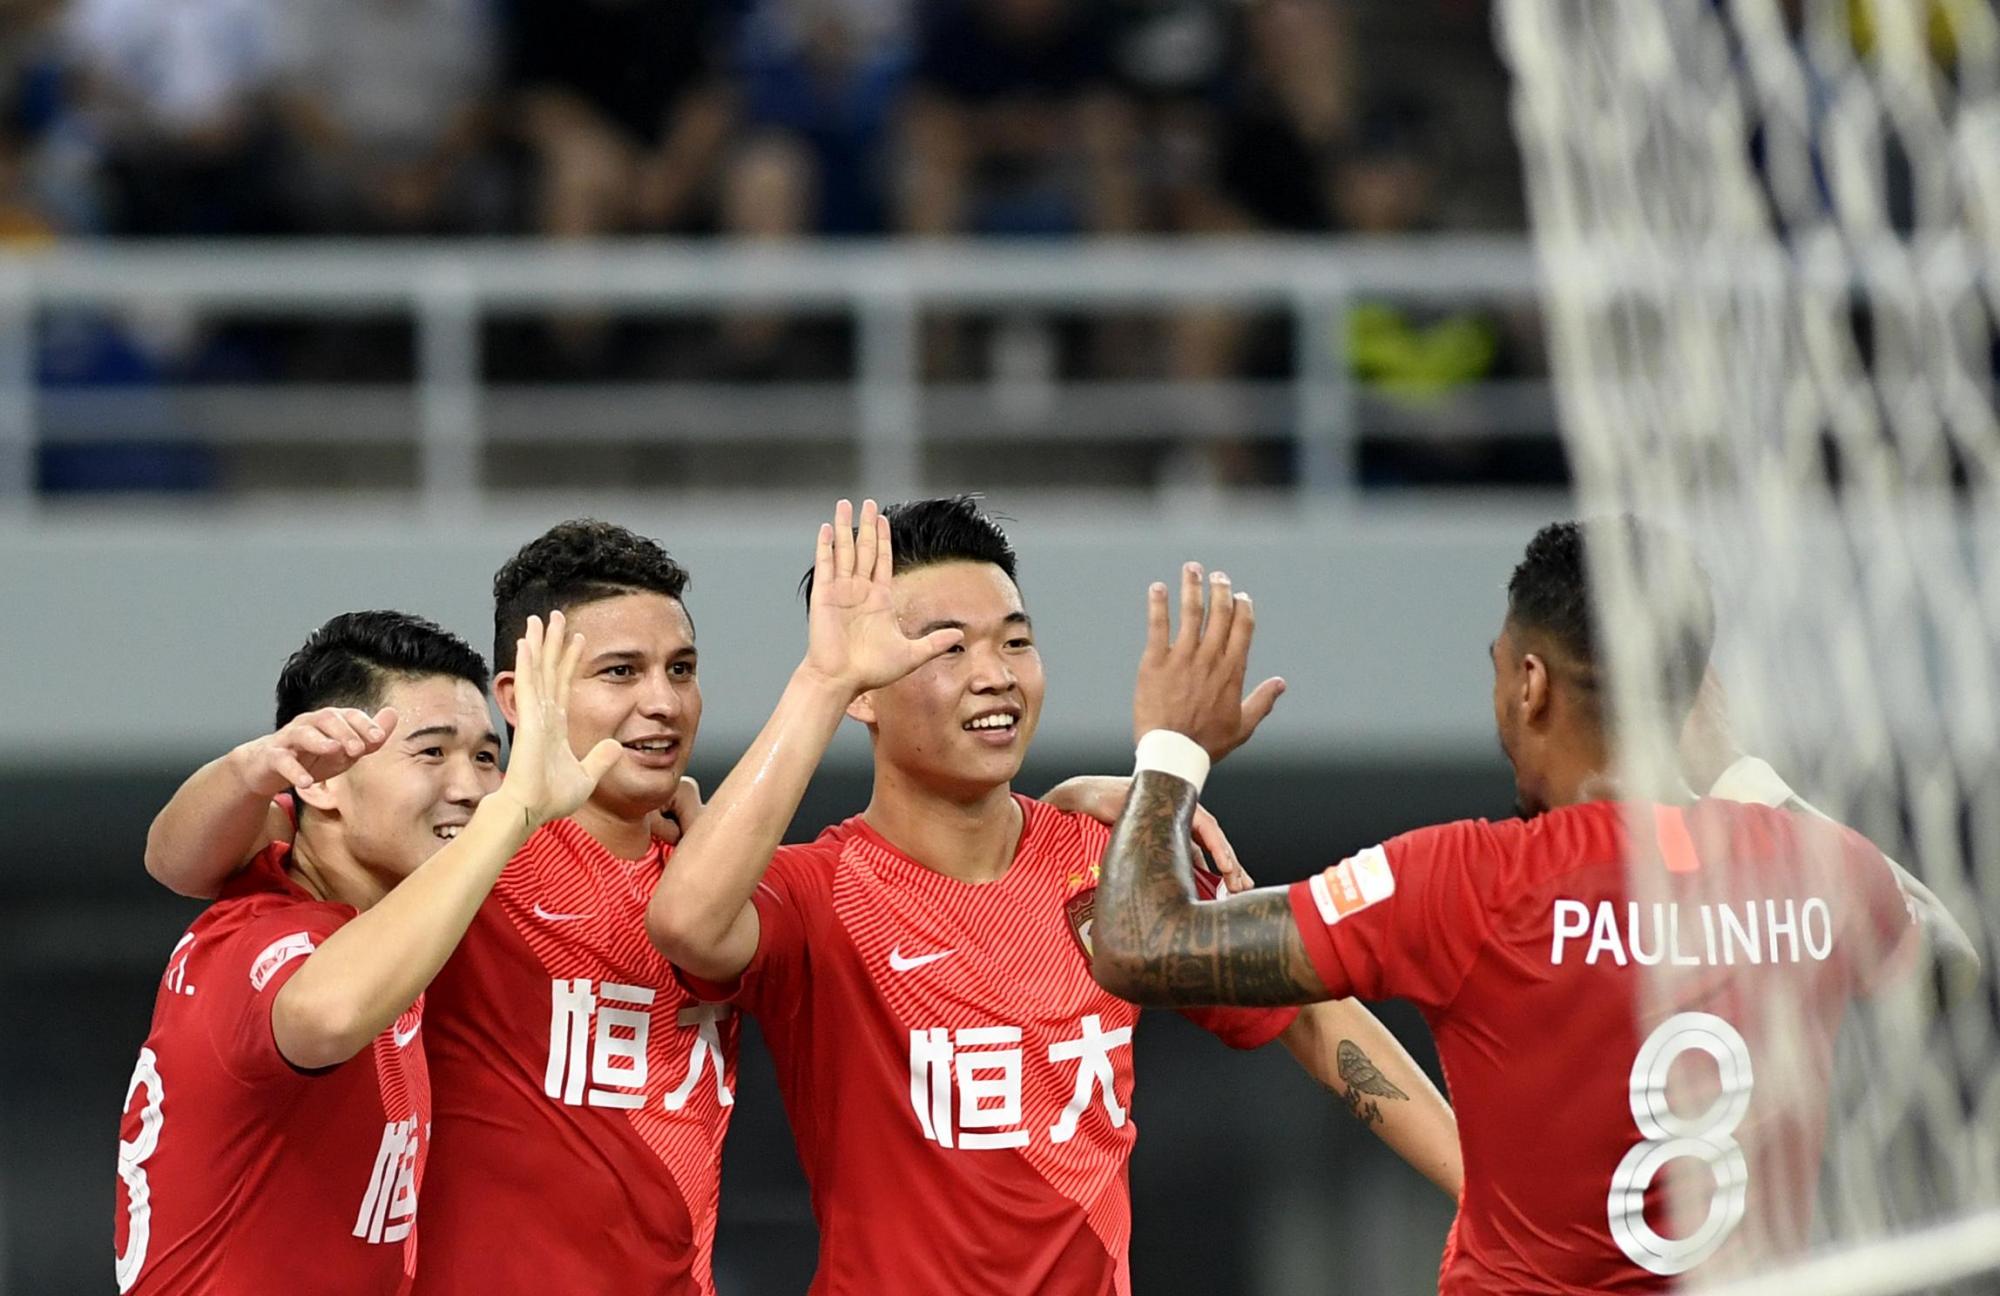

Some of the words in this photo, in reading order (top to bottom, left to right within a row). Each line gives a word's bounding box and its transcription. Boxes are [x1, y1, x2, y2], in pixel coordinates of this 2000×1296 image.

[1550, 896, 1833, 966] PAULINHO
[544, 977, 735, 1111] 恒大
[909, 1014, 1133, 1150] 恒大
[351, 1111, 432, 1245] 恒
[1607, 1011, 1754, 1276] 8
